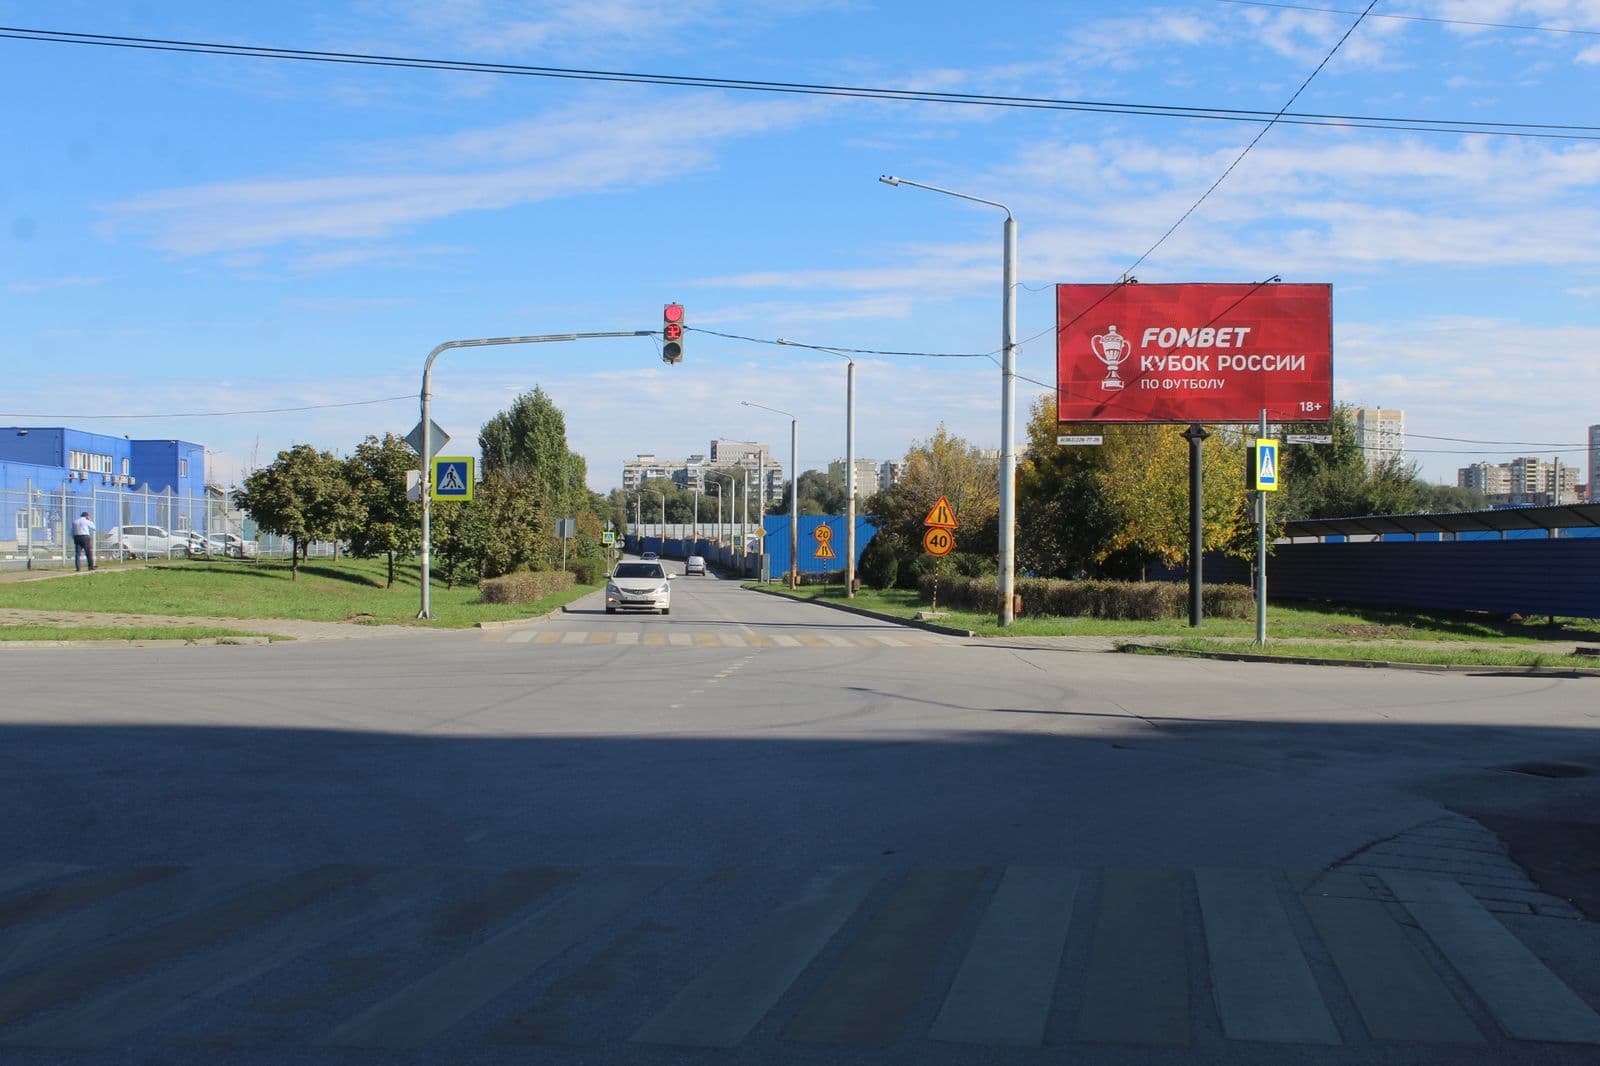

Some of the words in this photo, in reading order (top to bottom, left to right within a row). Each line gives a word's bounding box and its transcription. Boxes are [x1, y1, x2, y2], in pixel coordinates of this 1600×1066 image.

[1141, 327, 1250, 348] FONBET
[1141, 355, 1210, 371] КУБОК
[1218, 355, 1305, 371] РОССИИ
[1141, 379, 1159, 389] ПО
[1162, 378, 1225, 389] ФУТБОЛУ
[1299, 401, 1322, 412] 18+
[817, 529, 829, 539] 20
[929, 535, 947, 548] 40
